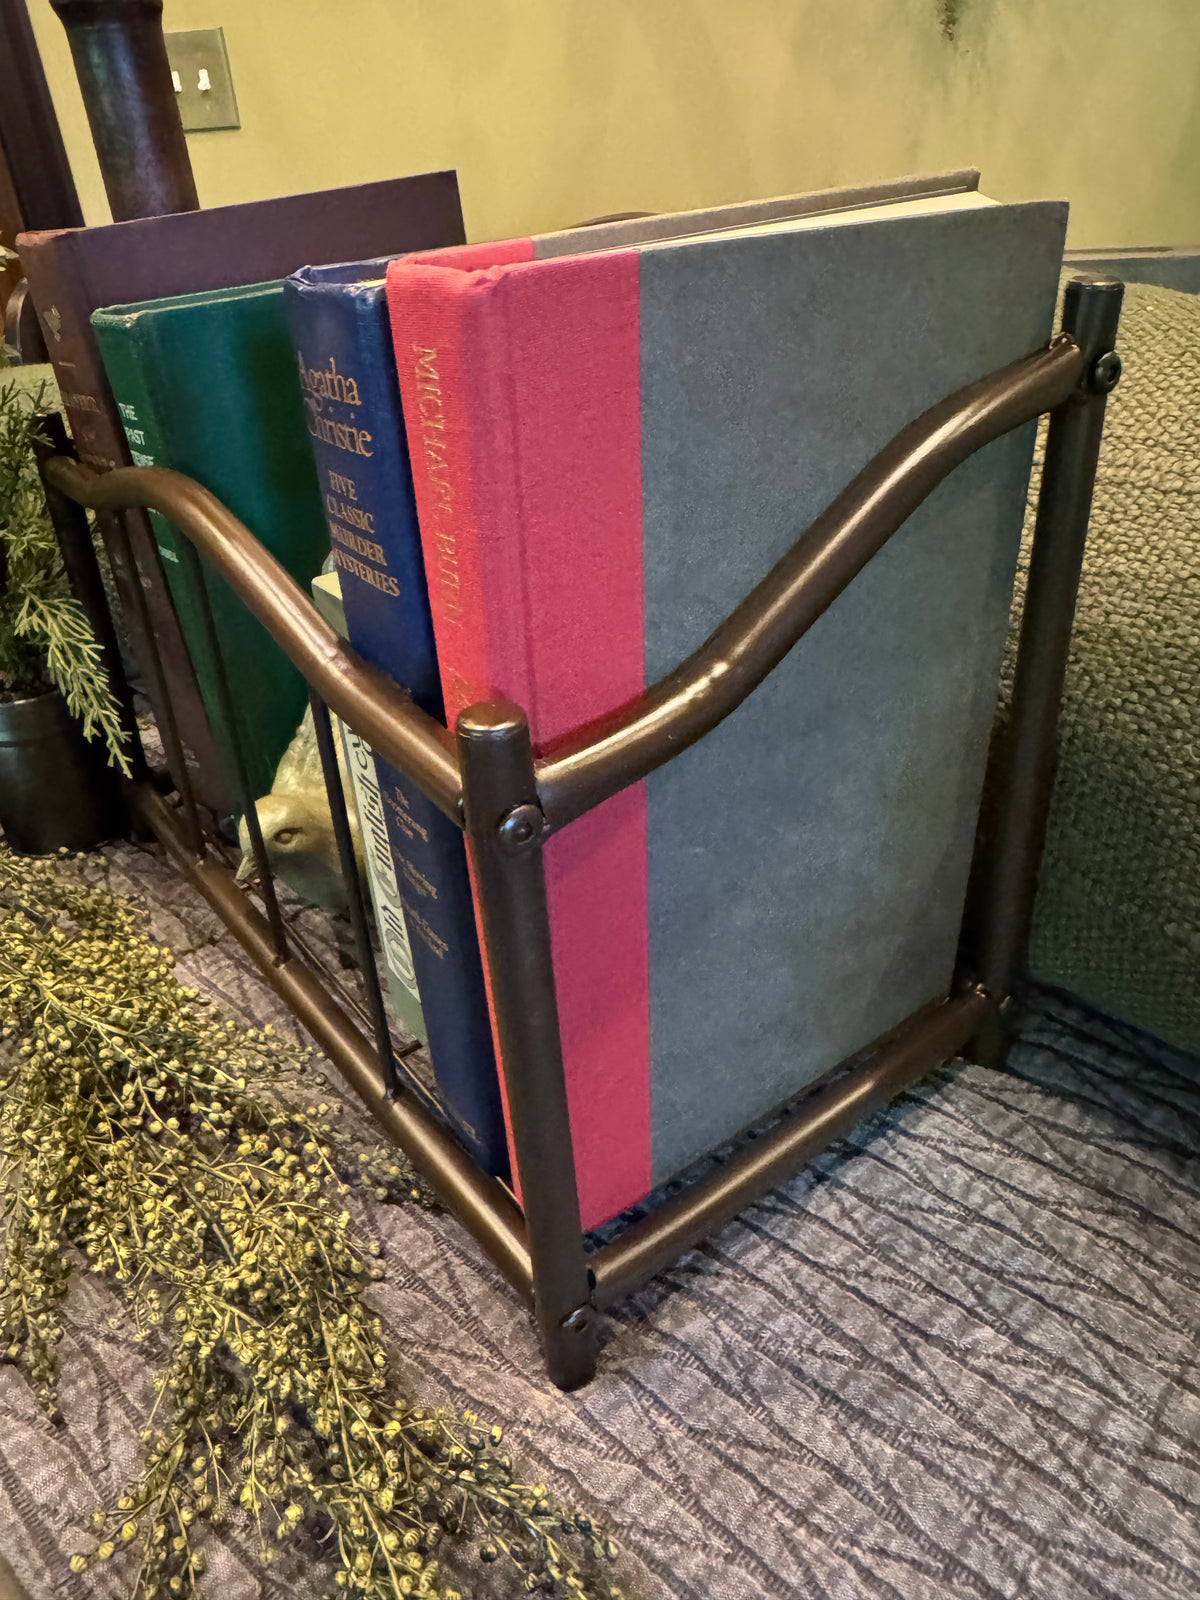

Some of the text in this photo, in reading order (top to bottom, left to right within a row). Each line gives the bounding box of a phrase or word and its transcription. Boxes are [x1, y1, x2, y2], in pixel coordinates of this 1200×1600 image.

[298, 350, 362, 411] Agatha
[118, 403, 138, 420] THE
[304, 397, 374, 457] Christie
[328, 470, 358, 500] FIVE
[327, 494, 375, 534] CLASSIC
[329, 519, 388, 566] MURDER
